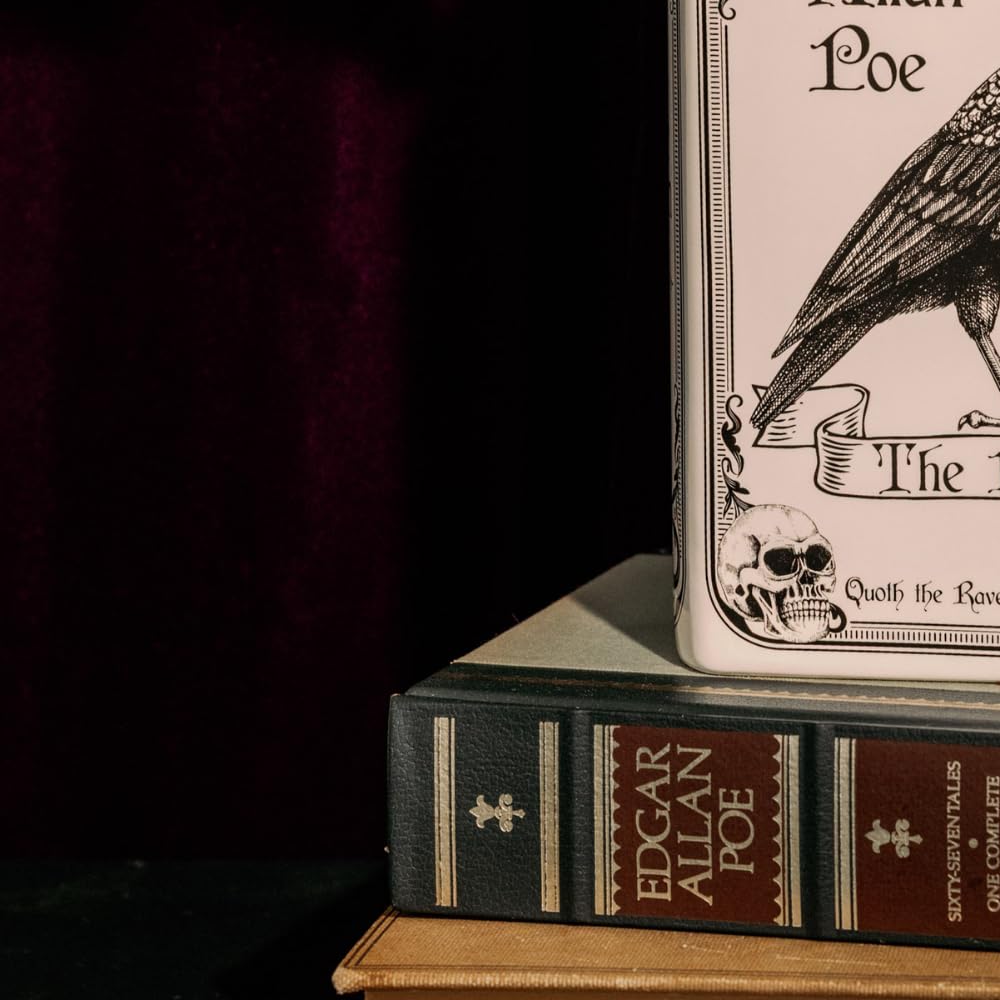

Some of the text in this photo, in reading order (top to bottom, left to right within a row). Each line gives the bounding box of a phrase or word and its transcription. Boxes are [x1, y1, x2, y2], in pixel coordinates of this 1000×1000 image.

[808, 24, 927, 93] Poe
[872, 442, 965, 495] The
[844, 576, 905, 611] Quoth
[915, 580, 943, 612] the
[635, 743, 671, 901] EDGAR
[676, 744, 713, 906] ALLAN
[717, 787, 755, 874] POE
[947, 760, 962, 922] SIXTY-SEVEN TALES
[985, 775, 1000, 913] ONE COMPLETE
